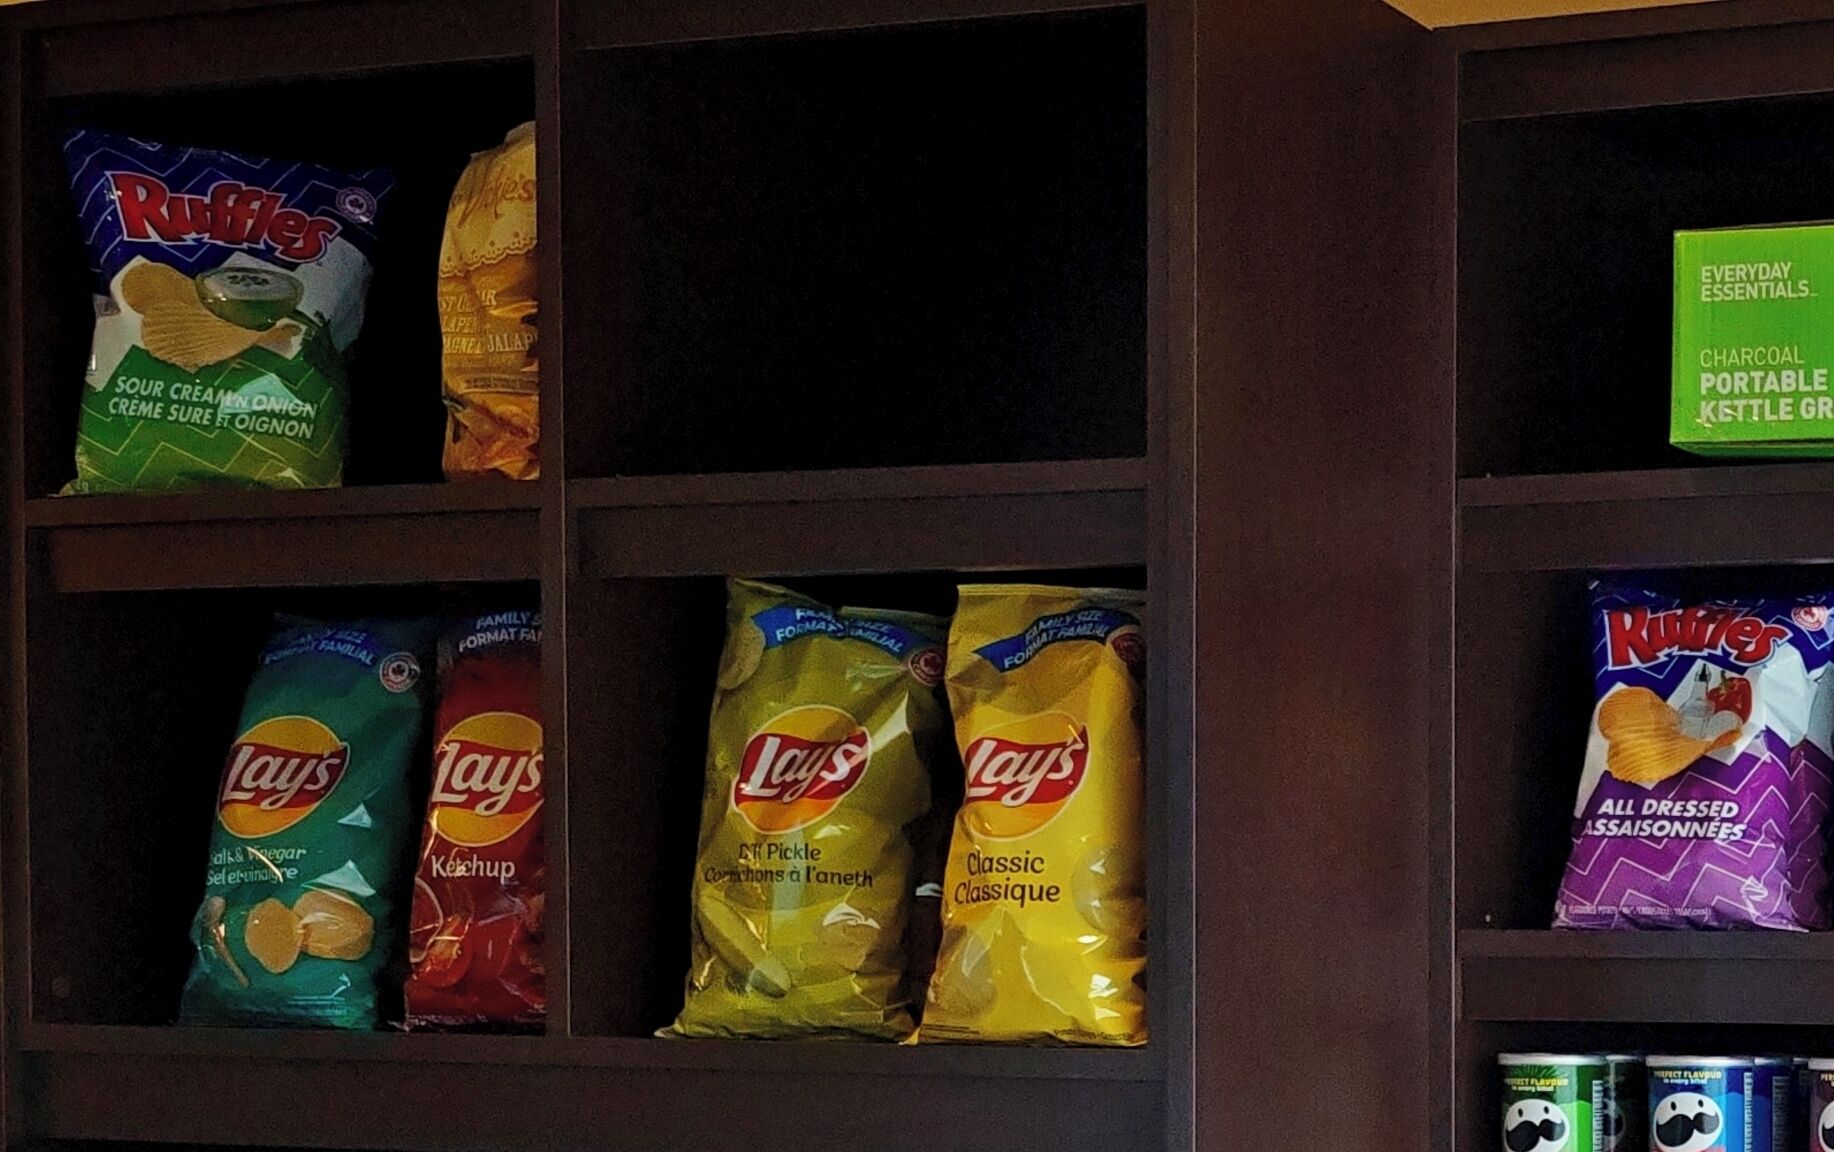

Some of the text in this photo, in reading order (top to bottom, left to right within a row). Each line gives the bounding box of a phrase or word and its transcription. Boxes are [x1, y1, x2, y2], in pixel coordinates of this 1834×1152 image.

[104, 171, 342, 263] Ruffles
[1700, 262, 1792, 284] EVERYDAY
[1700, 347, 1805, 369] CHARCOAL
[1700, 369, 1828, 395] PORTABLE
[115, 376, 318, 419] SOUR ONION
[108, 395, 314, 440] CRÈME SURE ET OIGNON
[1700, 398, 1795, 424] KETTLE
[475, 609, 531, 630] FAMILY
[458, 627, 515, 653] FORMAT
[1602, 606, 1793, 670] Ruffles
[222, 745, 342, 811] Lay's
[430, 742, 543, 816] Lay's
[741, 736, 868, 804] Lay's
[967, 733, 1085, 807] Lay's
[1598, 799, 1739, 819] ALL DRESSED
[1581, 818, 1747, 840] ASSAISONNÉES
[767, 843, 822, 861] Pickle
[967, 851, 1045, 876] Classic
[431, 854, 516, 881] Ketchup
[789, 866, 874, 888] à l'aneth
[954, 881, 1061, 908] Classique
